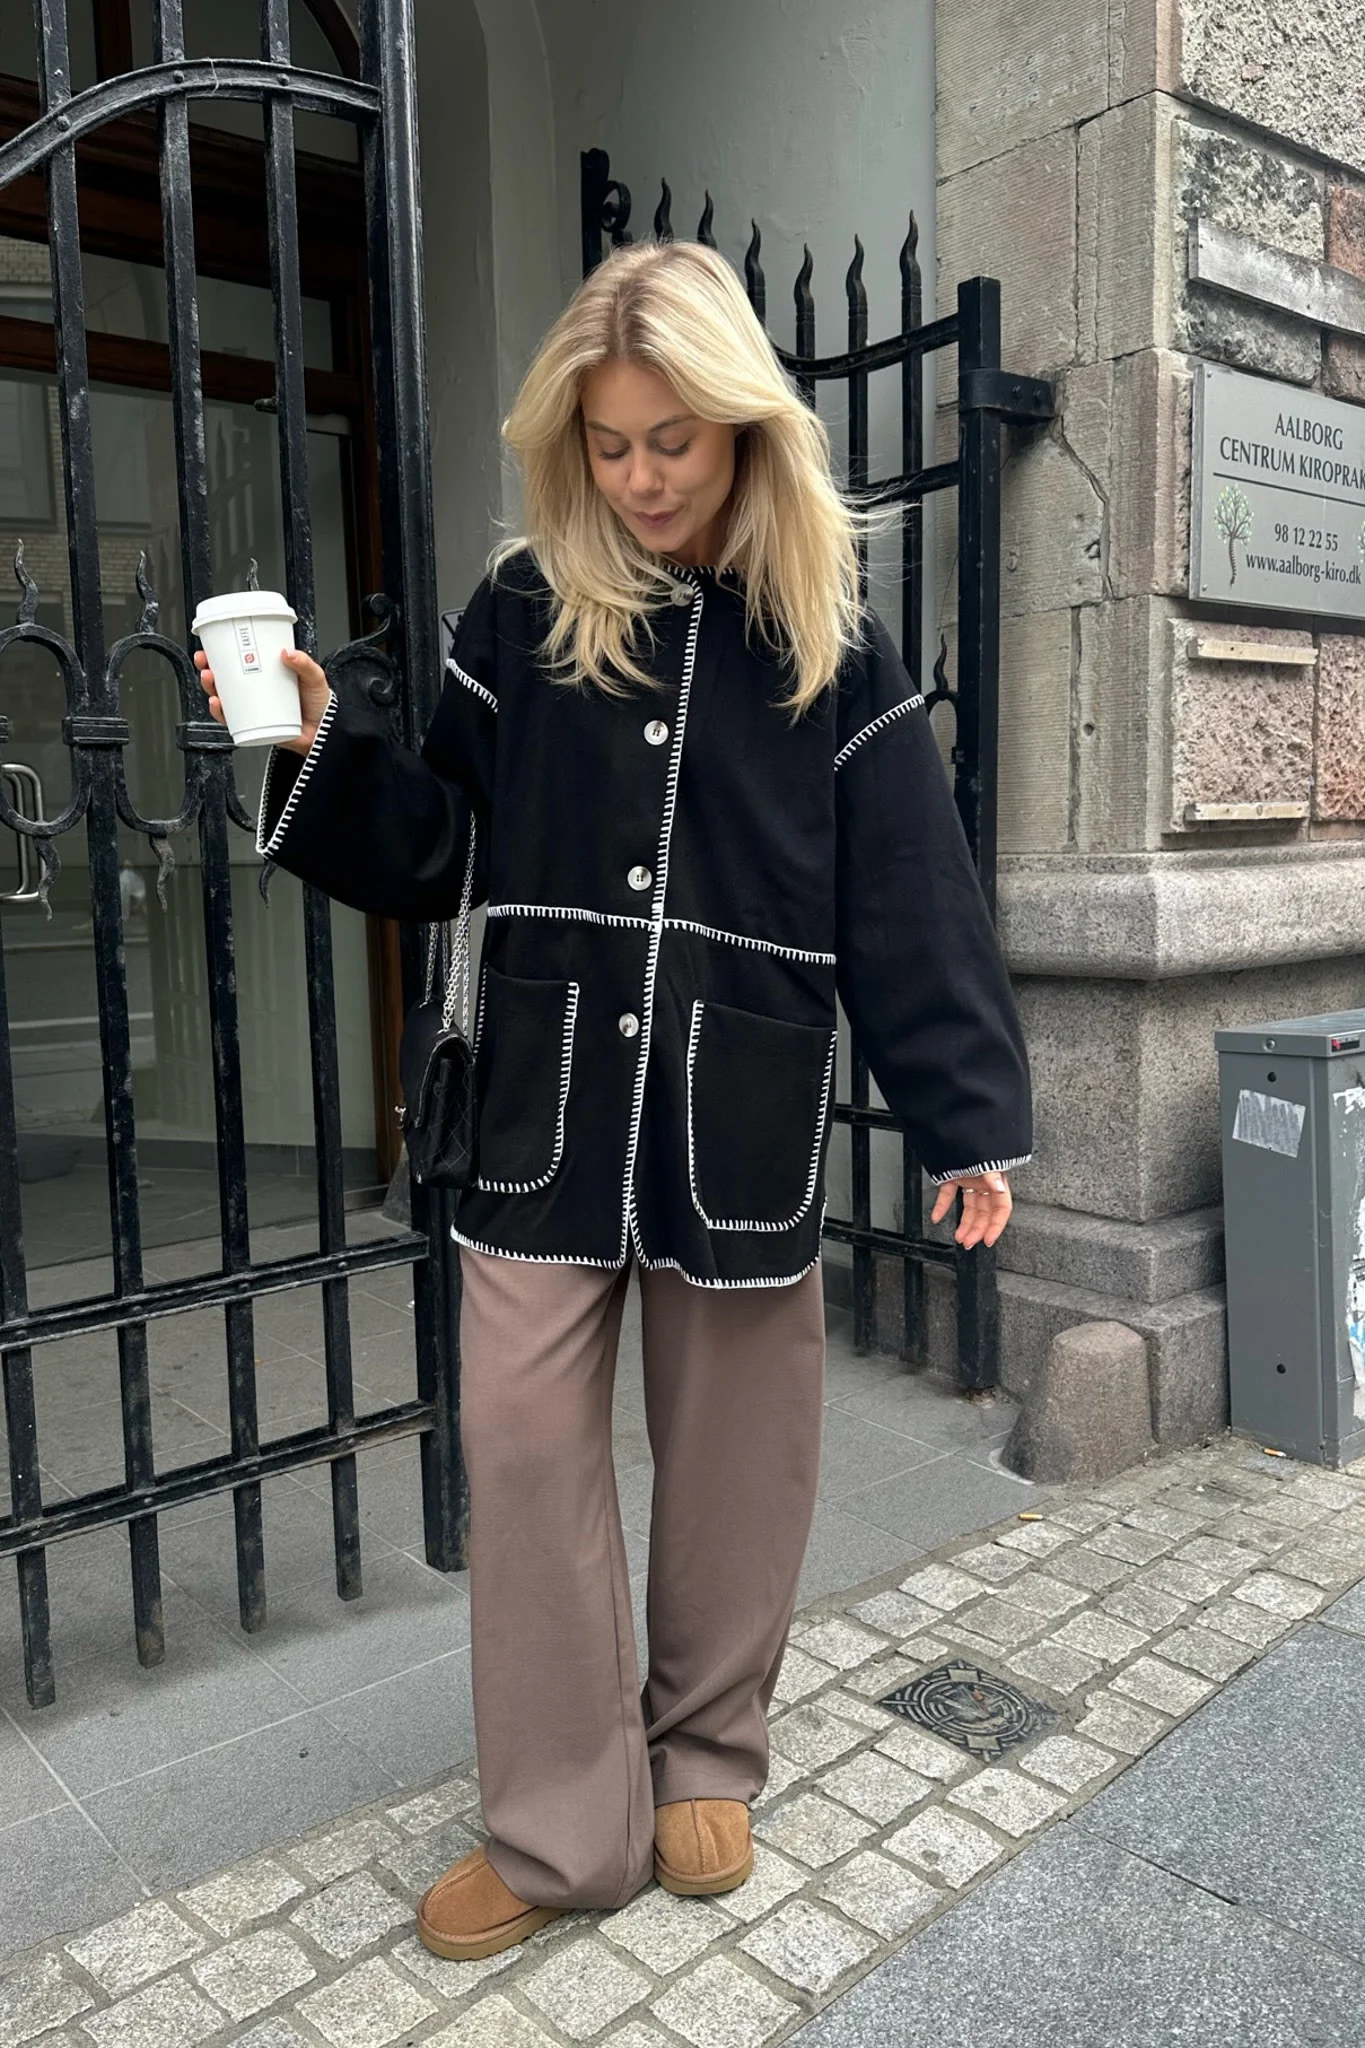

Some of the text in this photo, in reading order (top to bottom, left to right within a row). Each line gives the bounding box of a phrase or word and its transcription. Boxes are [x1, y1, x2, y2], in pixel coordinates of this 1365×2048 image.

[1275, 413, 1343, 450] AALBORG
[1220, 437, 1295, 474] CENTRUM
[1275, 523, 1338, 551] 98 12 22 55
[1246, 554, 1362, 584] www.aalborg-kiro.dk
